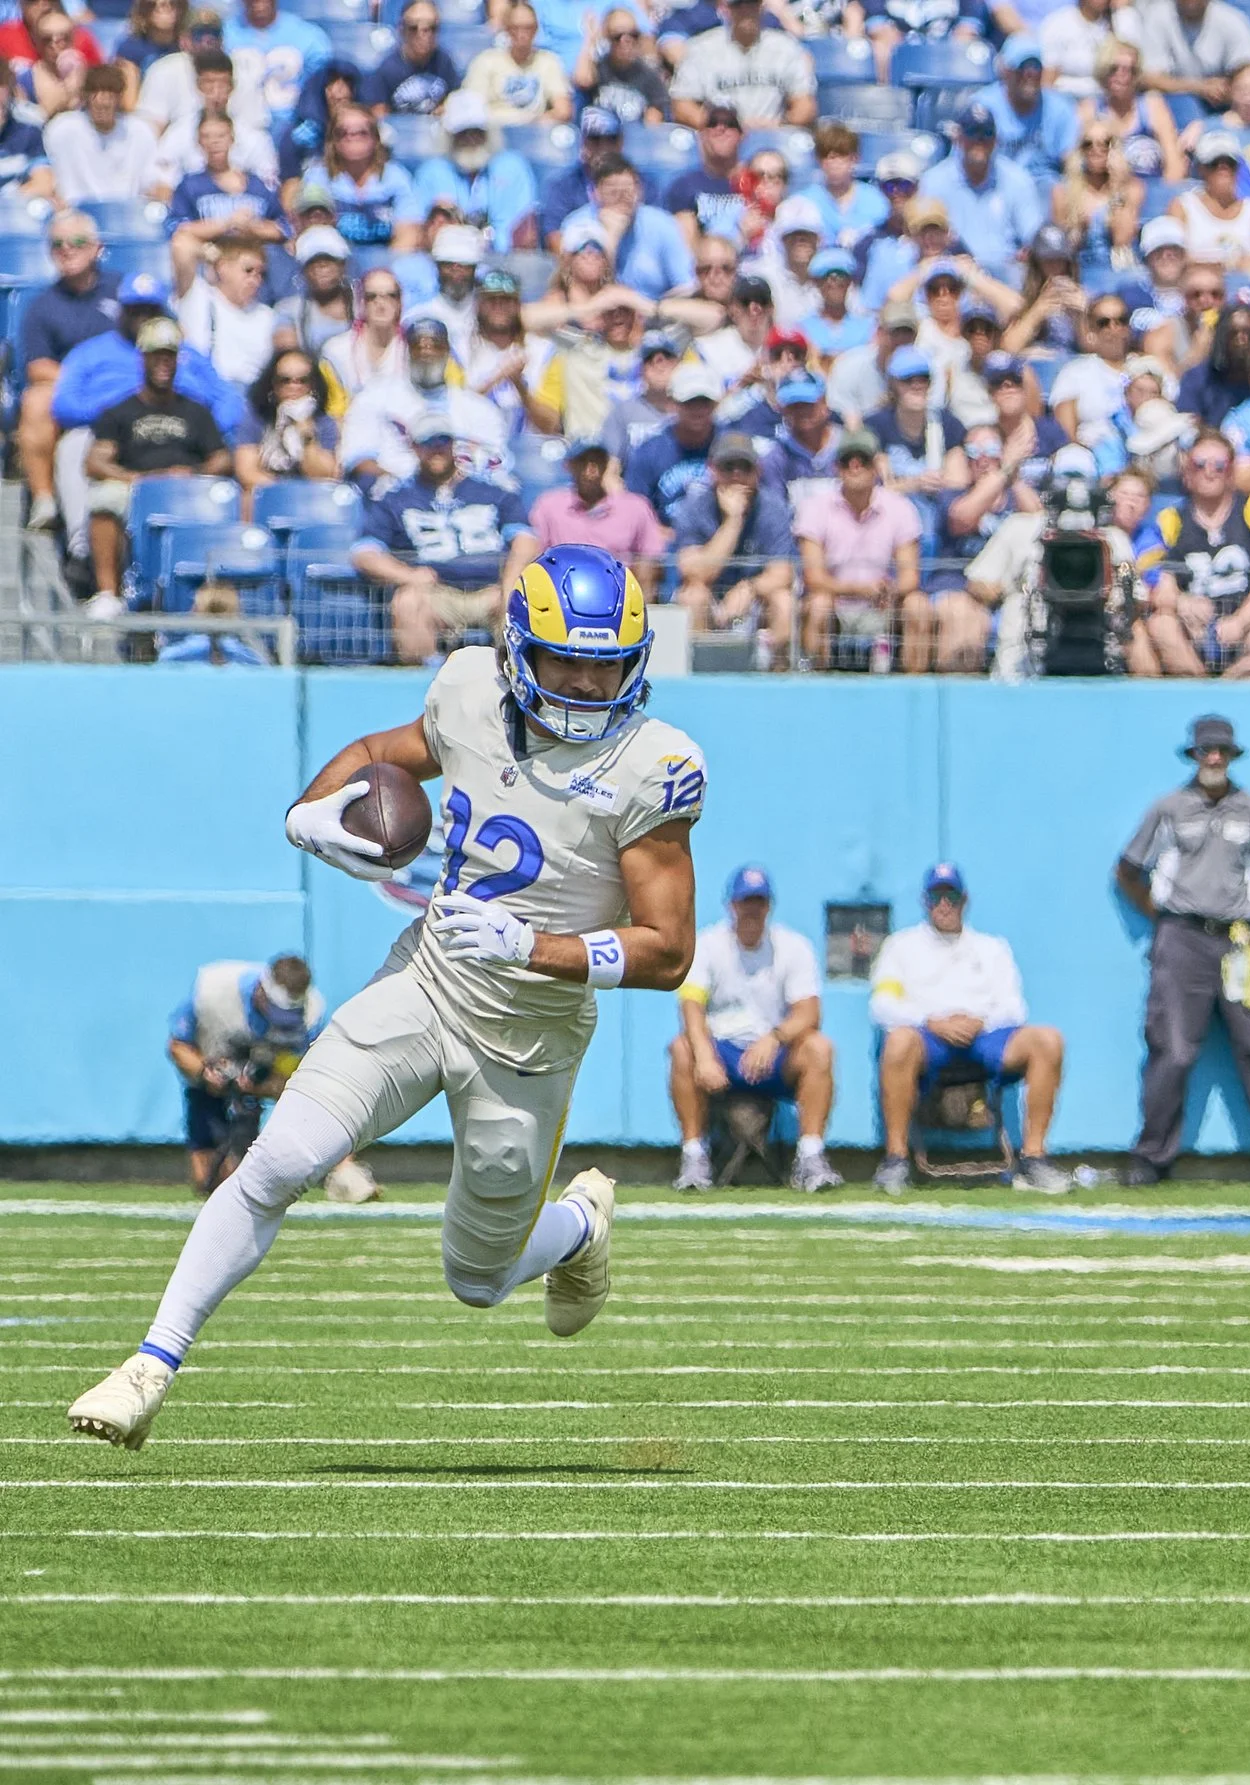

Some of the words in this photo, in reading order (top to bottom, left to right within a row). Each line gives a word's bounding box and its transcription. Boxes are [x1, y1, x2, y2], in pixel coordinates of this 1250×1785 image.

[579, 631, 609, 640] RAMS
[661, 769, 704, 813] 12
[445, 785, 545, 926] 12
[589, 937, 619, 966] 12
